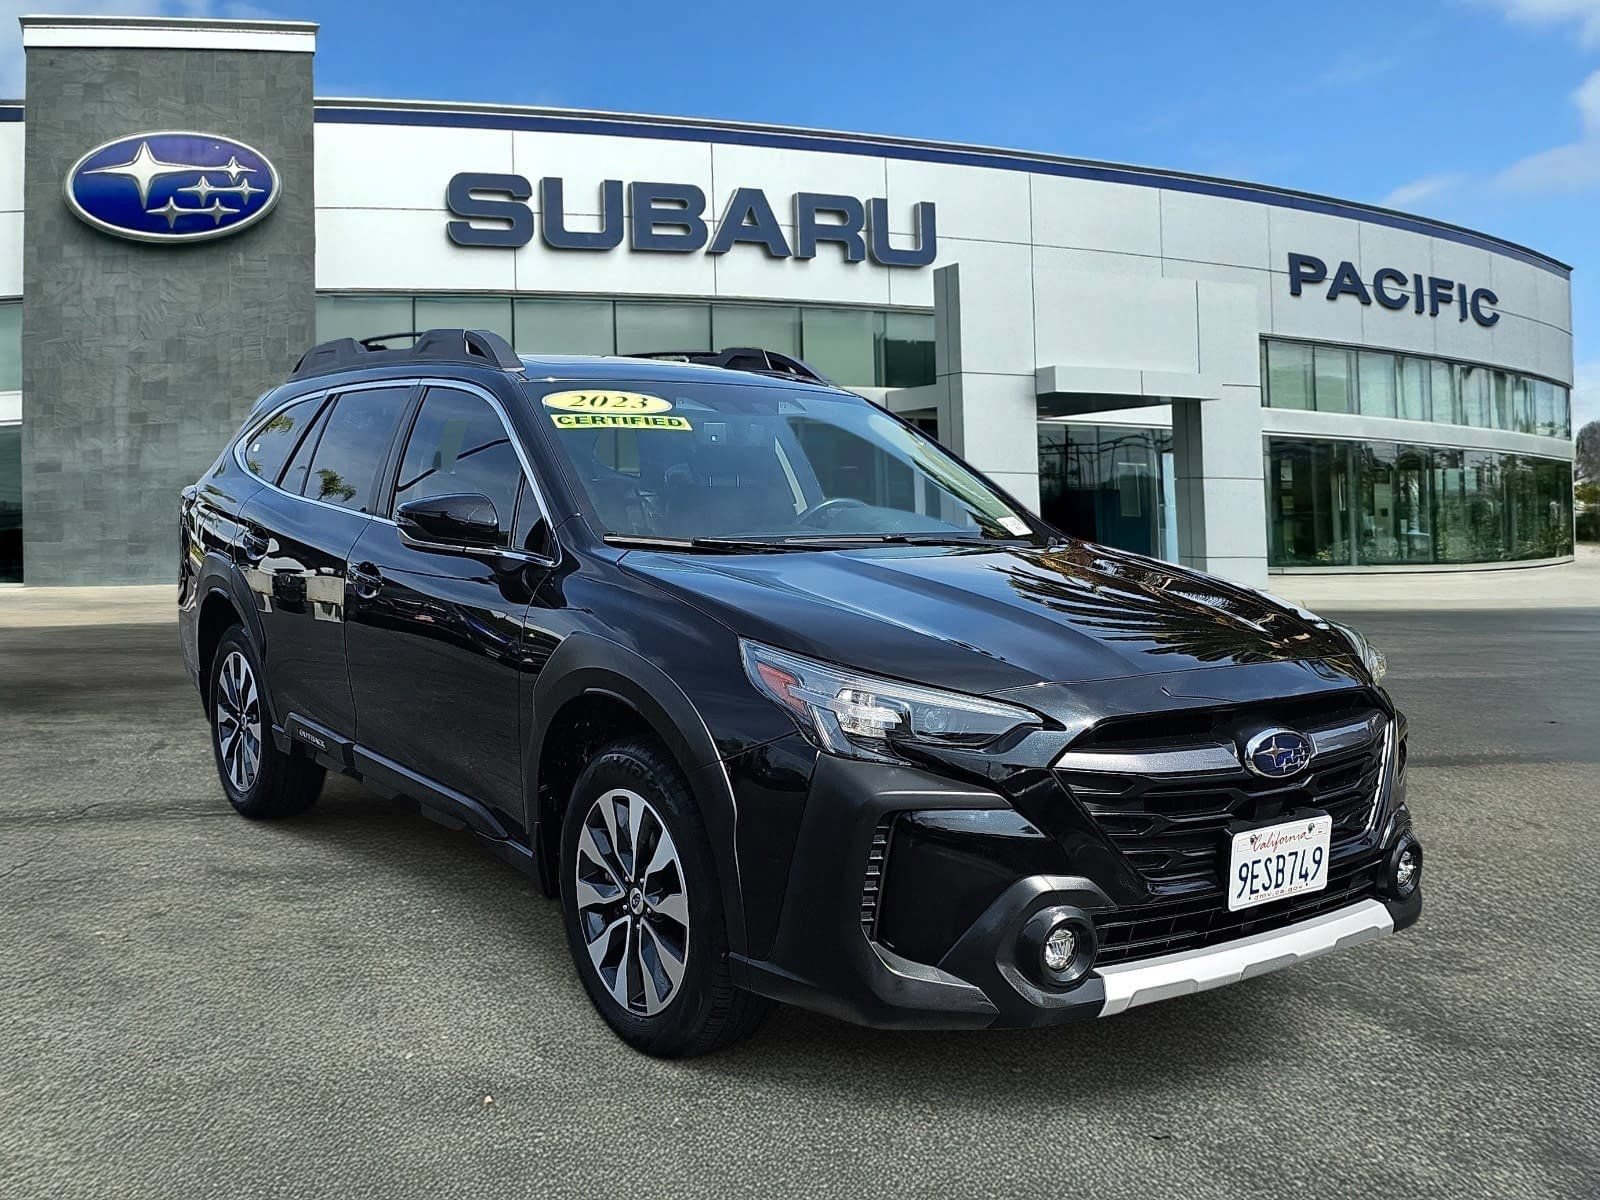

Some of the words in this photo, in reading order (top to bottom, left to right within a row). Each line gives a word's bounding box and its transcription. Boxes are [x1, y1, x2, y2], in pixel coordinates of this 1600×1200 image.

[447, 172, 937, 267] SUBARU
[1288, 252, 1500, 327] PACIFIC
[568, 395, 648, 409] 2023
[557, 415, 683, 427] CERTIFIED
[299, 729, 326, 748] OUTBACK
[1252, 831, 1312, 853] California
[1237, 846, 1323, 899] 9ESB749
[1253, 885, 1304, 901] dmv.ca.gov
